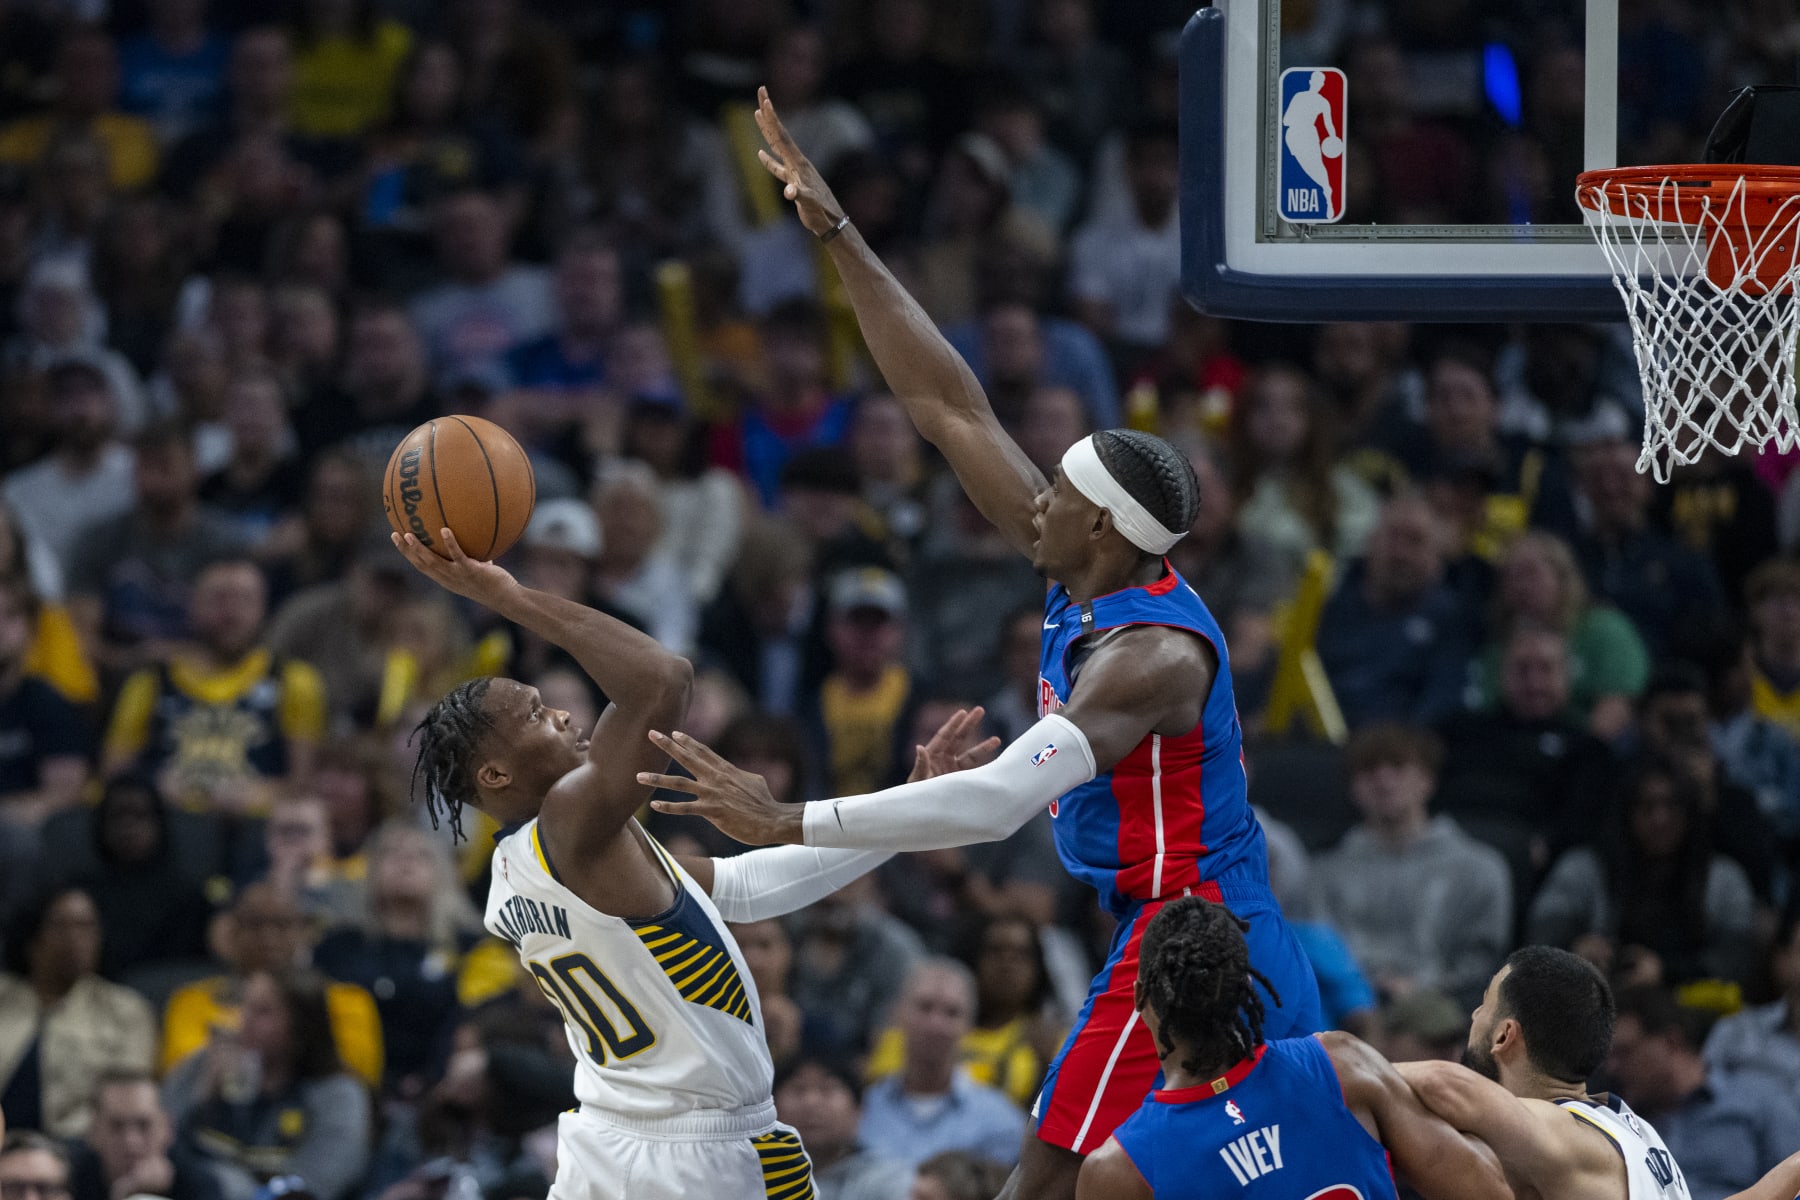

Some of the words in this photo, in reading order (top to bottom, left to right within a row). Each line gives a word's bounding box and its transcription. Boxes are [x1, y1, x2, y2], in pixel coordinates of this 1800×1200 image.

[1287, 188, 1320, 213] NBA
[400, 446, 434, 546] Wilson
[1219, 1124, 1284, 1187] IVEY
